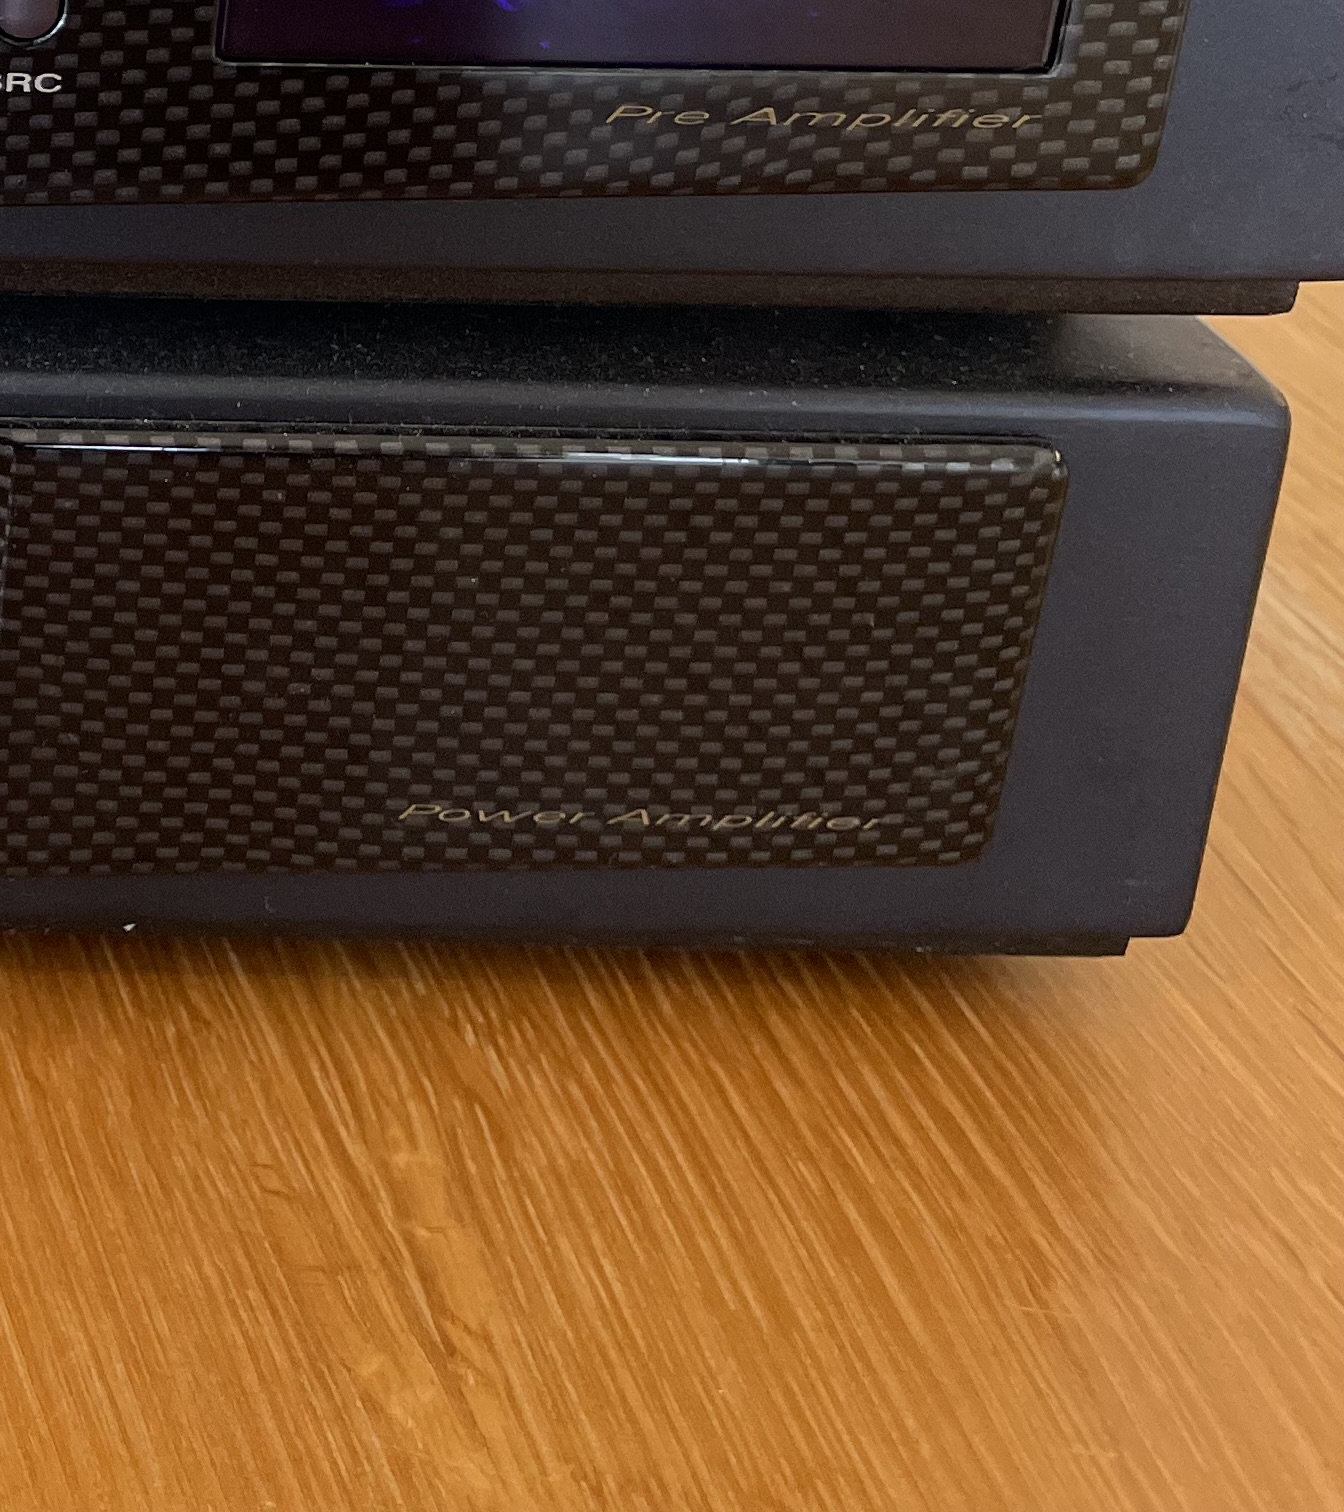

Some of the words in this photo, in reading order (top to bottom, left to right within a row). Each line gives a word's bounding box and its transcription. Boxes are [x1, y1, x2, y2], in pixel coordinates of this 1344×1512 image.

[605, 103, 710, 126] Pre
[730, 105, 1043, 132] Amplifier
[397, 803, 596, 825] Power
[606, 807, 881, 832] Amplifier
